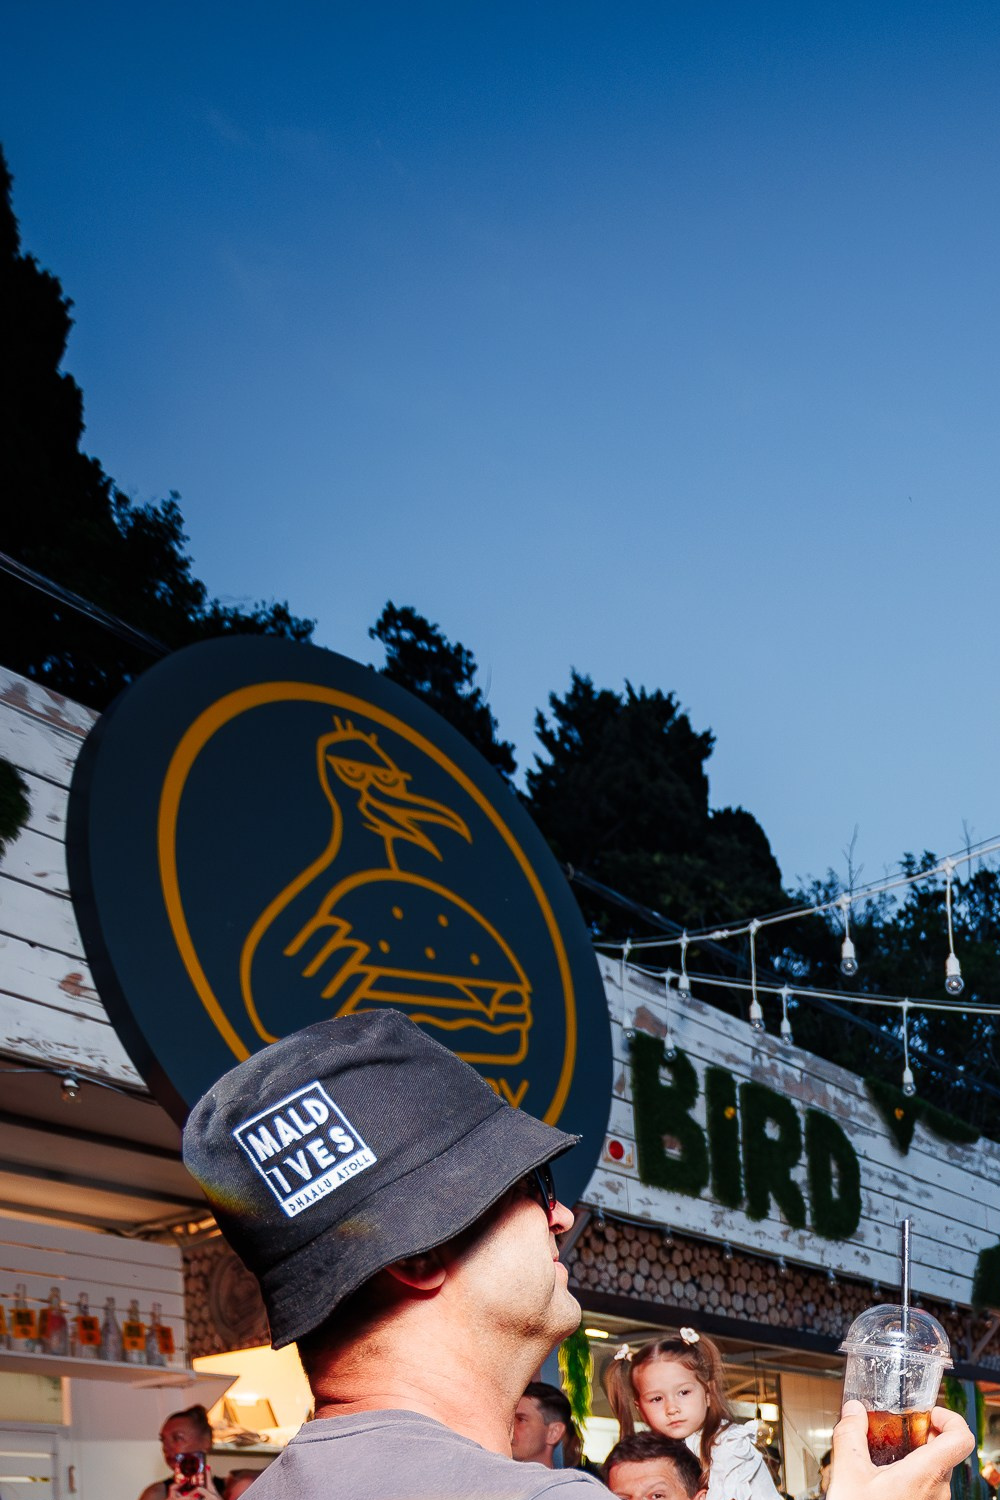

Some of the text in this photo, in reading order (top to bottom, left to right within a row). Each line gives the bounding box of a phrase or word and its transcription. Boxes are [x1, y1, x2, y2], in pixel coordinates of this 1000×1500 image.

[246, 1097, 330, 1163] MALD
[265, 1125, 355, 1194] IVES
[630, 1031, 862, 1241] BIRD
[288, 1154, 371, 1212] DHAALU ATOLL
